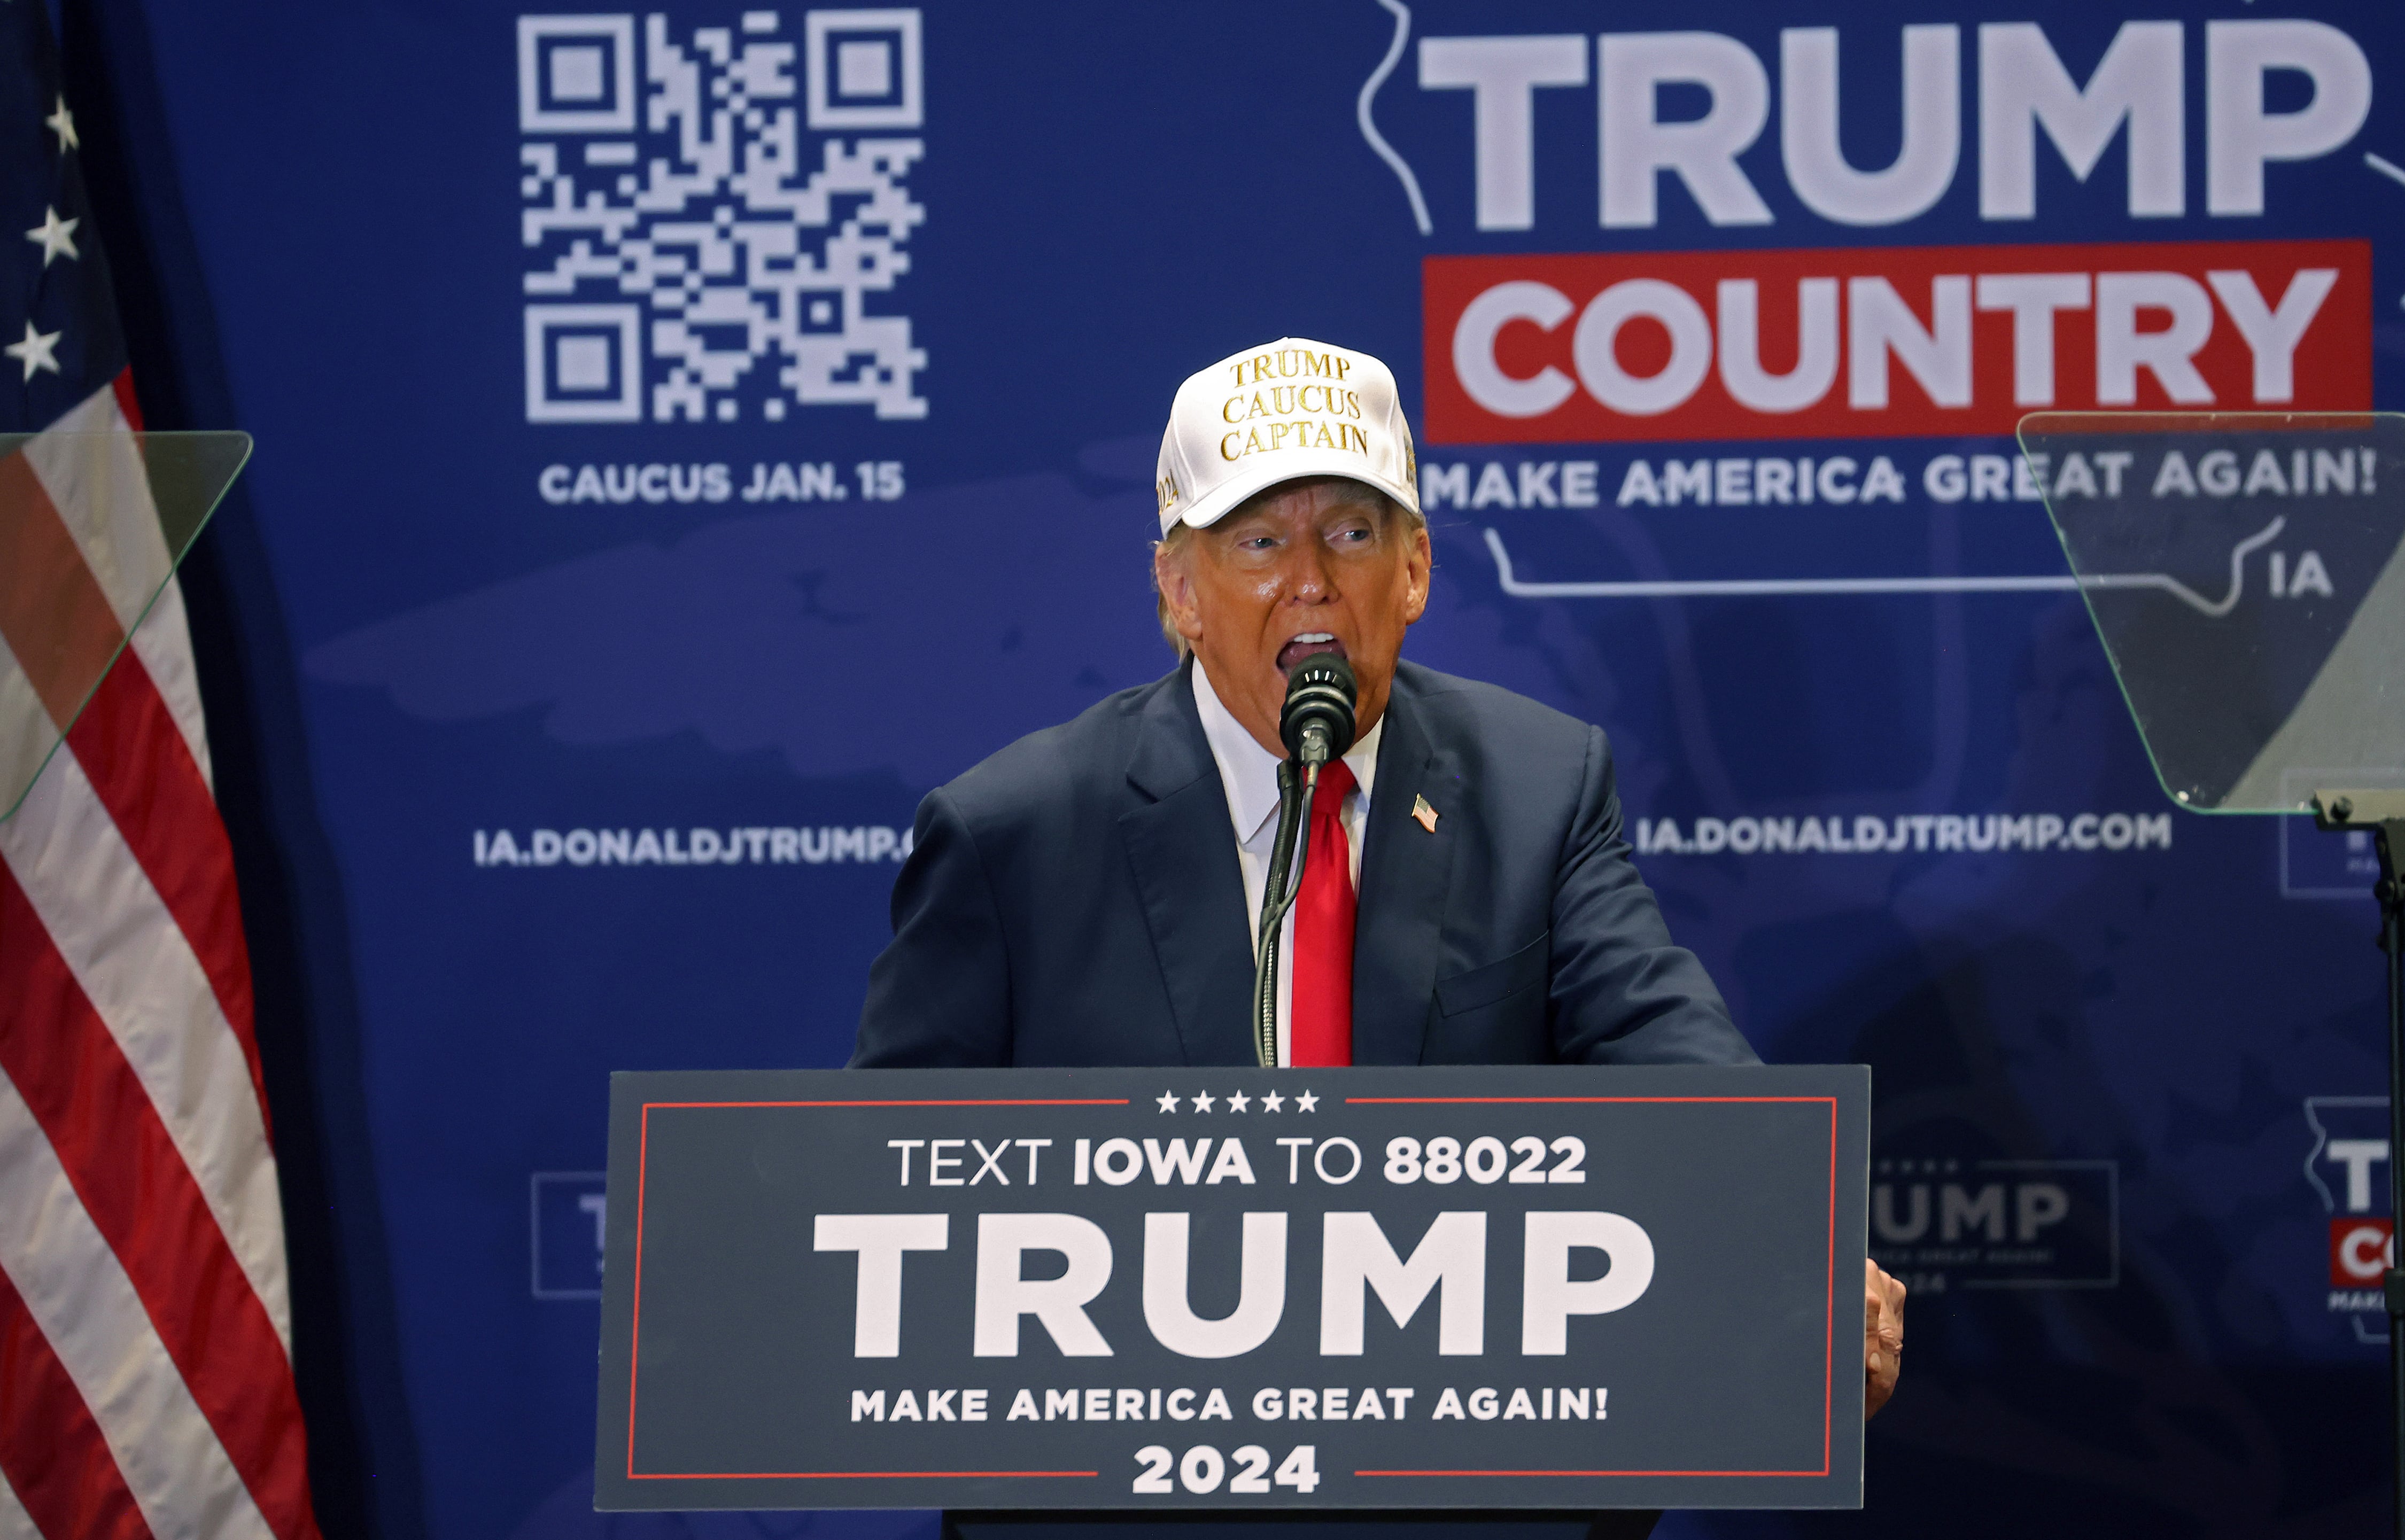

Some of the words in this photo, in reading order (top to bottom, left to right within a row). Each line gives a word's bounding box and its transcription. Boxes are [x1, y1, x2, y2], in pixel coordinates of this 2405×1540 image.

[1417, 19, 2373, 232] TRUMP
[1452, 268, 2340, 418] COUNTRY
[1230, 349, 1350, 388] TRUMP
[1223, 385, 1361, 423] CAUCUS
[1221, 421, 1368, 461] CAPTAIN
[539, 463, 732, 504] CAUCUS
[742, 462, 847, 502] JAN.
[856, 461, 905, 501] 15
[1424, 460, 1599, 509] MAKE
[1616, 456, 1905, 507] AMERICA
[1924, 452, 2134, 503] GREAT
[2151, 449, 2377, 498] AGAIN!
[2268, 551, 2333, 598] IA
[1635, 813, 2172, 854] IA.DONALDJTRUMP.COM
[887, 1139, 1053, 1186] TEXT
[1074, 1138, 1256, 1186] IOWA
[1276, 1137, 1362, 1185] TO
[1384, 1135, 1586, 1184] 88022
[813, 1211, 1655, 1359] TRUMP
[851, 1390, 989, 1422] MAKE
[1006, 1389, 1233, 1422] AMERICA
[1252, 1388, 1414, 1421] GREAT
[1432, 1387, 1608, 1420] AGAIN!
[1132, 1445, 1320, 1495] 2024
